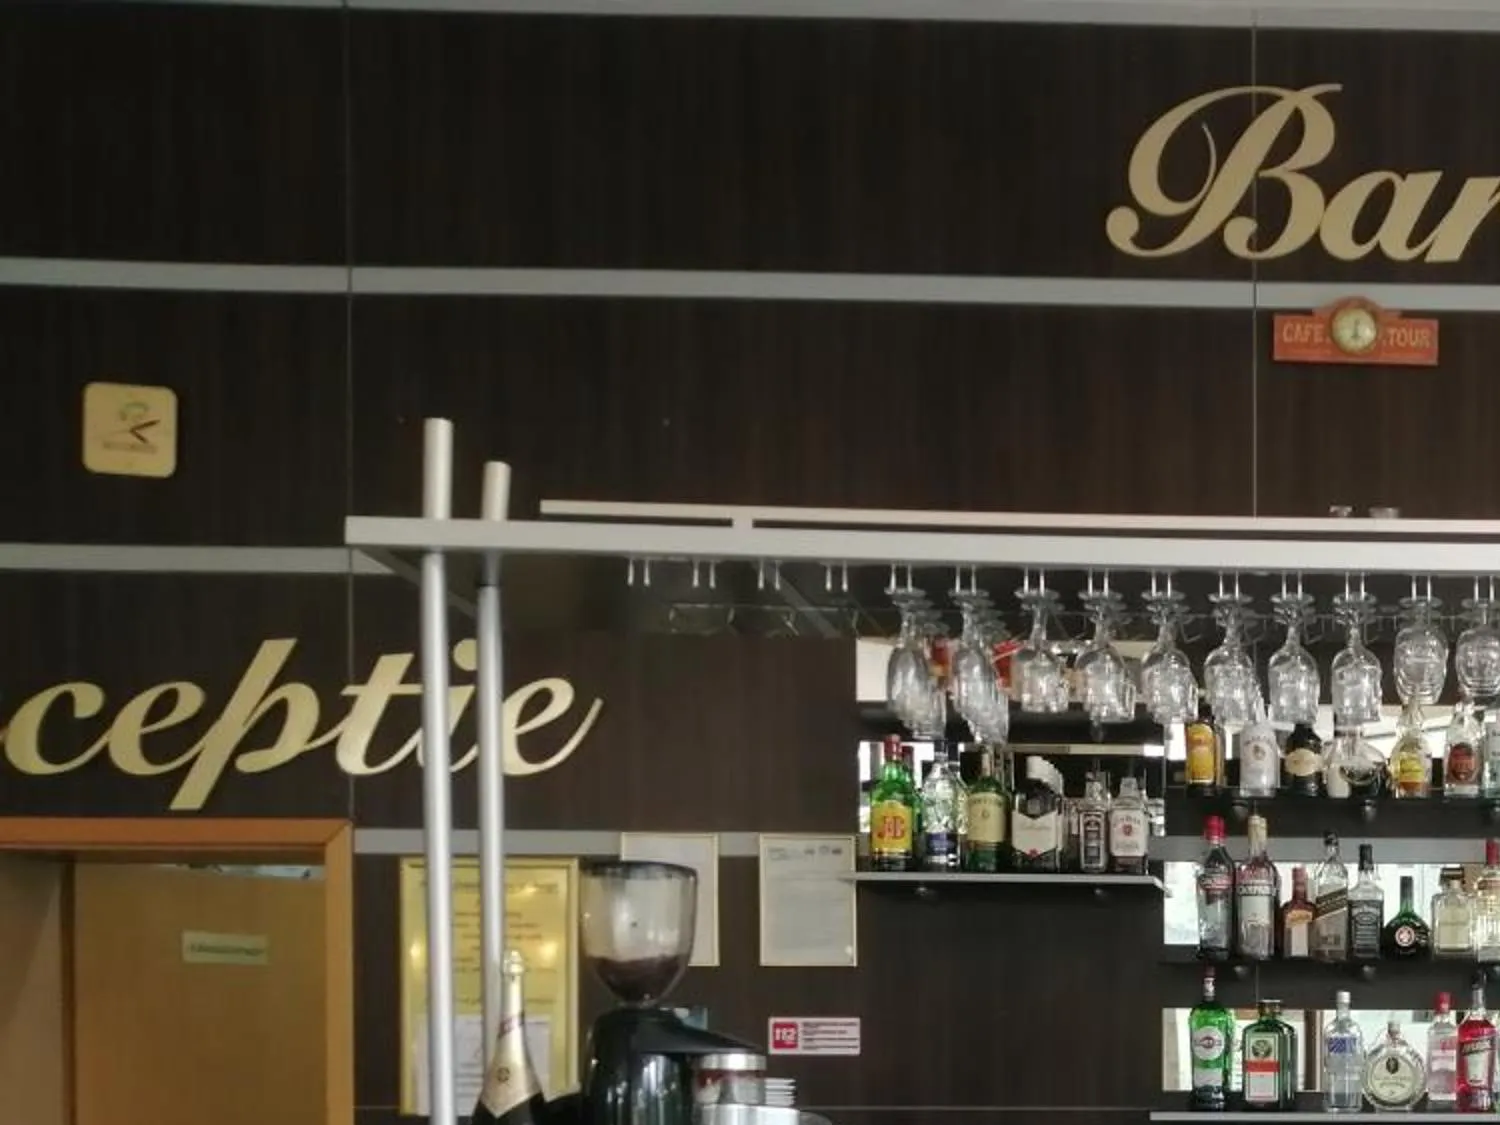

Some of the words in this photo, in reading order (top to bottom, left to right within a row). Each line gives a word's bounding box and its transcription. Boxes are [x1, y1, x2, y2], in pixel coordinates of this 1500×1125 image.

[1282, 322, 1326, 344] CAFE
[1388, 327, 1431, 349] TOUR
[775, 1027, 797, 1041] 112
